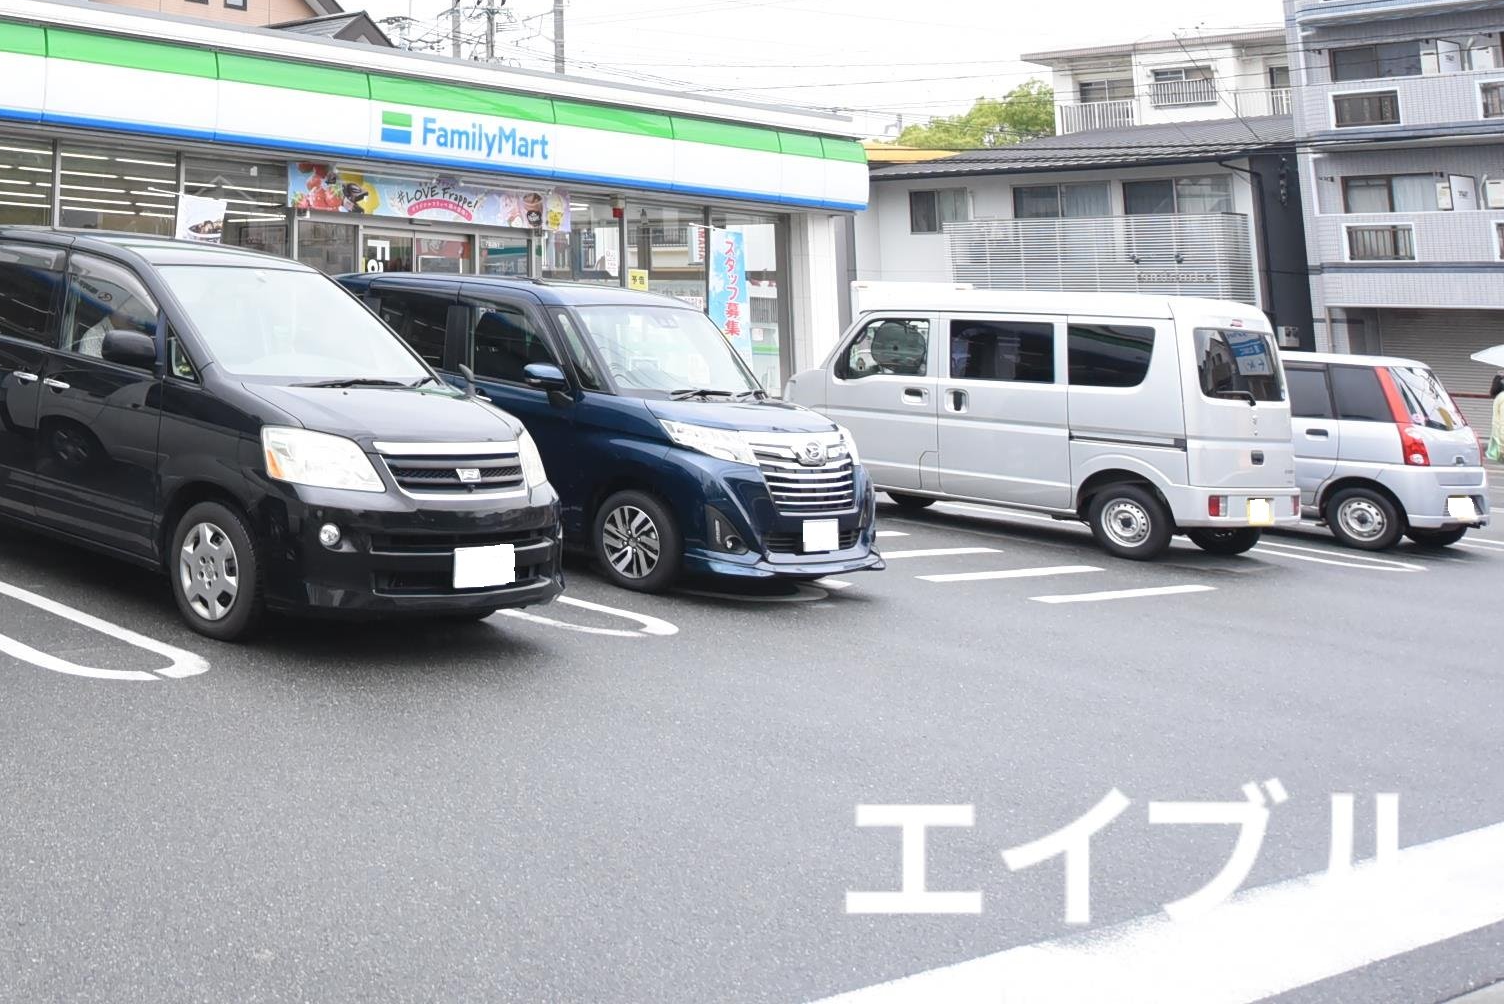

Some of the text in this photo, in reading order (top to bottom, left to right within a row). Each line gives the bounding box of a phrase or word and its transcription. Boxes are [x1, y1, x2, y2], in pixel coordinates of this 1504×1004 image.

[422, 117, 549, 160] FamilyMart
[397, 185, 479, 212] #LOVE Frappe!
[724, 240, 740, 336] スタッフ募集
